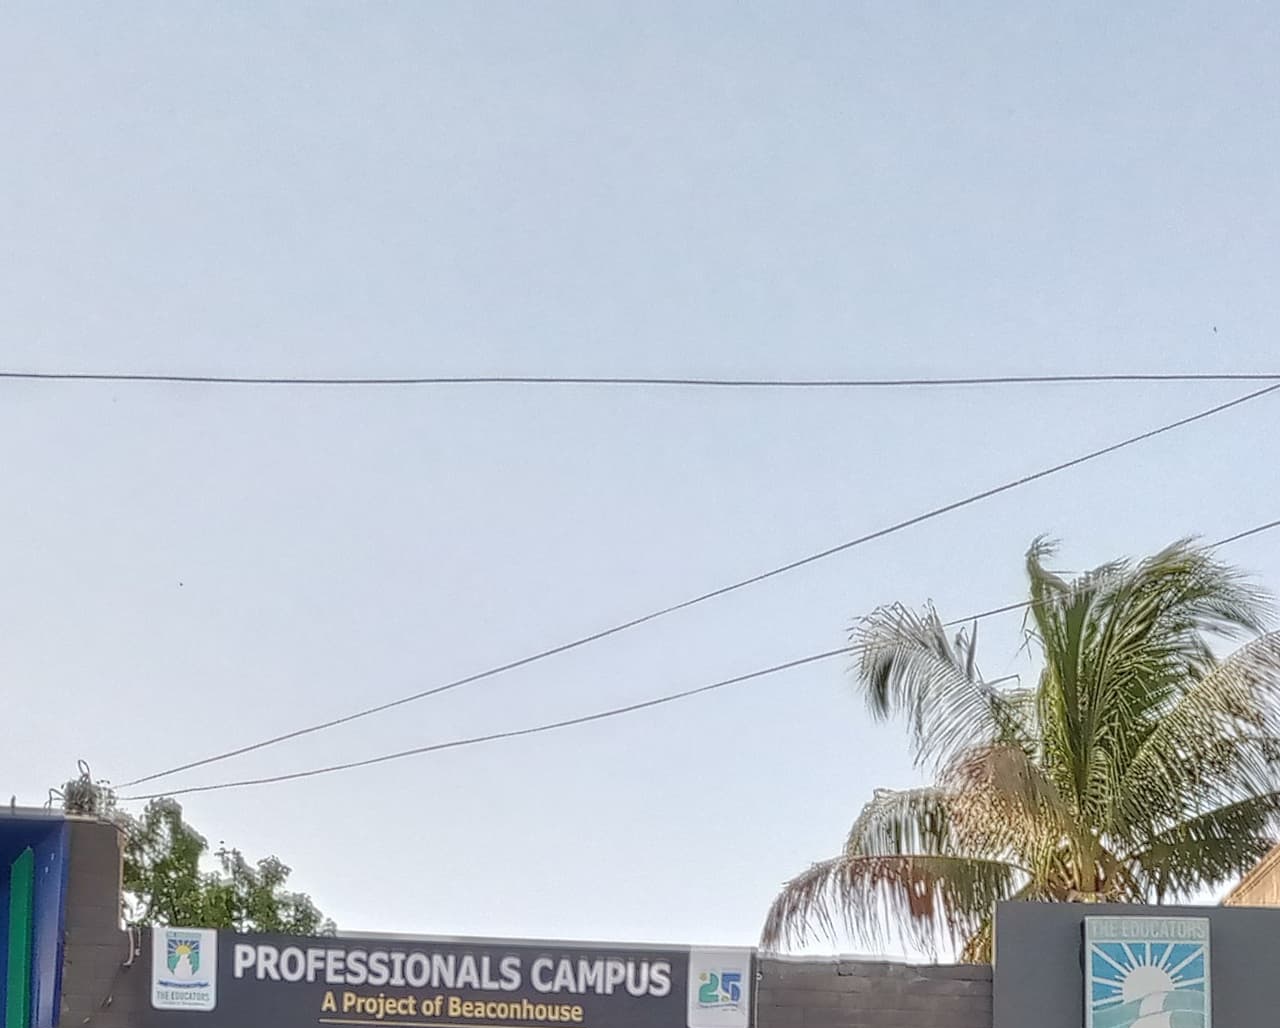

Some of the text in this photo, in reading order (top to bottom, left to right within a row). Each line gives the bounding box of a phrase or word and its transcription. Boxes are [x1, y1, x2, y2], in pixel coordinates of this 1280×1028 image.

[234, 944, 671, 997] PROFESSIONALS CAMPUS
[321, 991, 584, 1022] A Project of Beaconhouse
